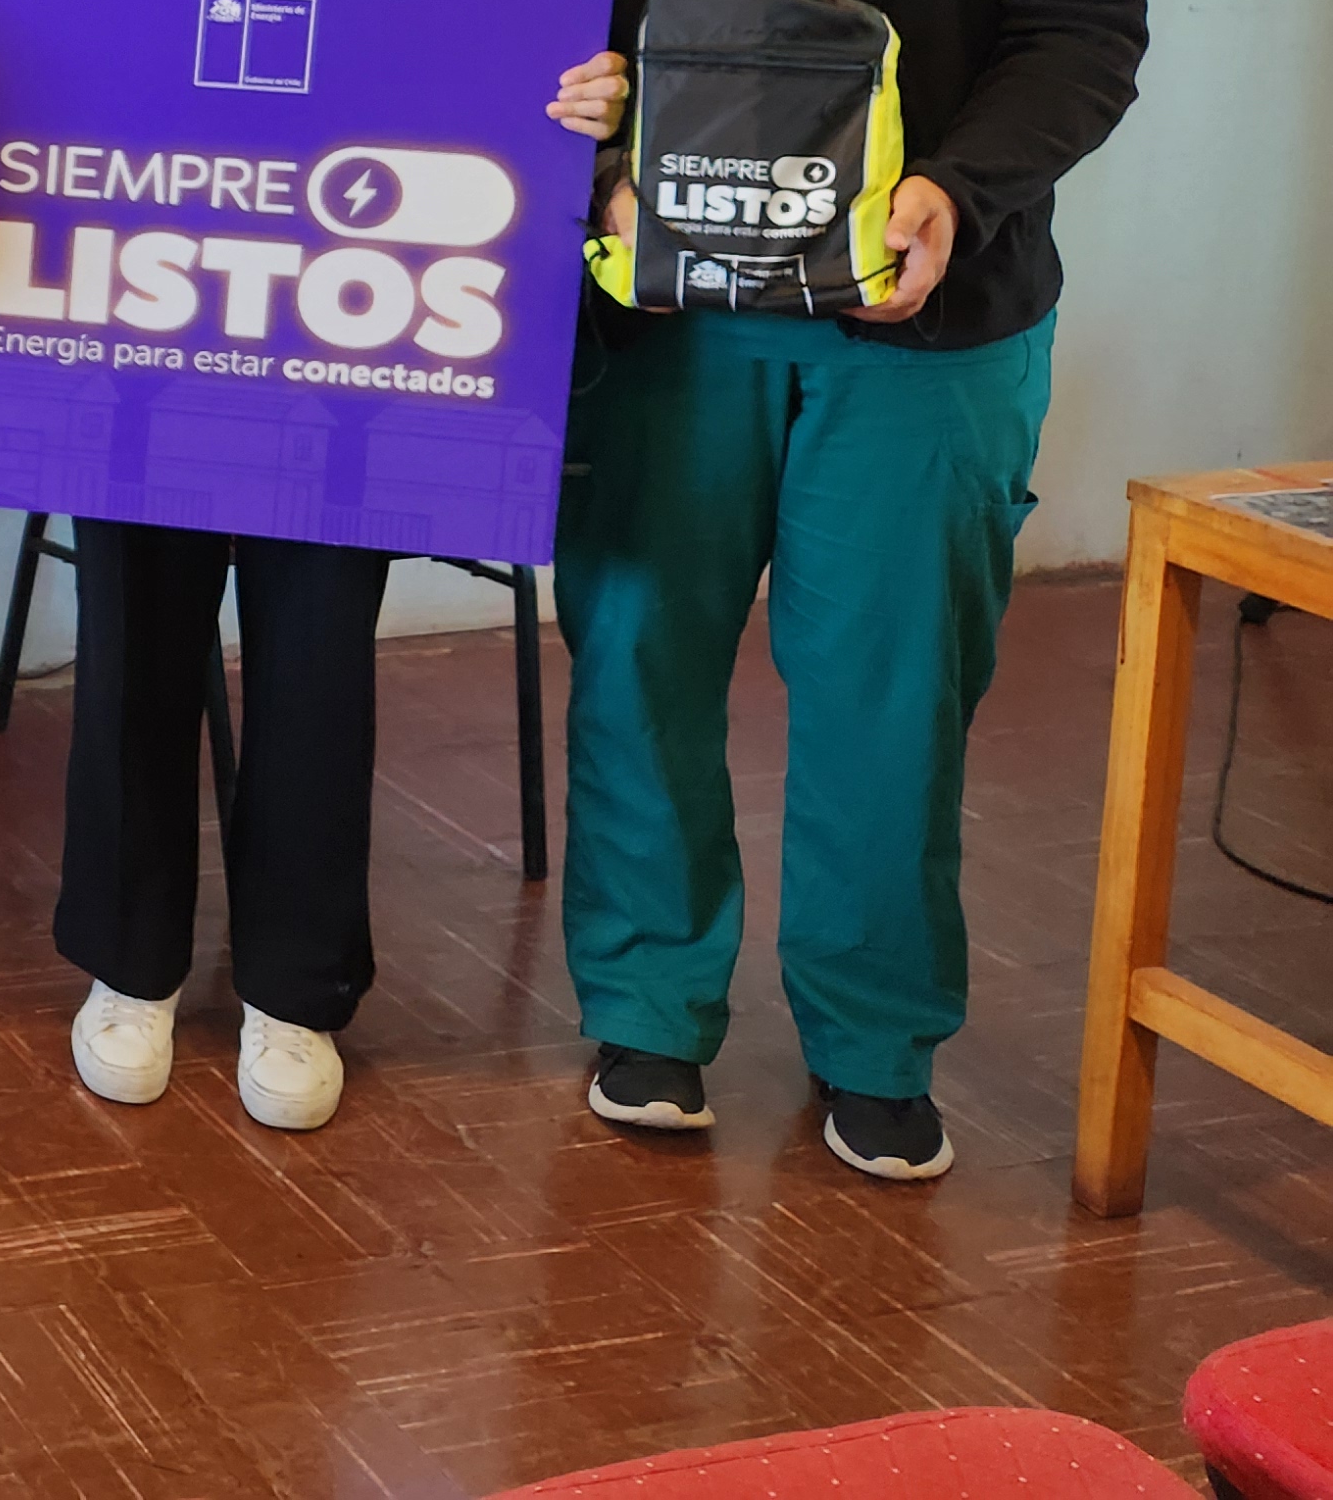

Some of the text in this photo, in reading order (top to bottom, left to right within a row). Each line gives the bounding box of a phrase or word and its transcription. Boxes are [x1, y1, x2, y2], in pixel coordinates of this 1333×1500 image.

[659, 153, 770, 182] SIEMPRE
[656, 181, 837, 227] LISTOS
[114, 340, 184, 371] para
[194, 348, 275, 377] estar
[283, 354, 495, 399] conectados
